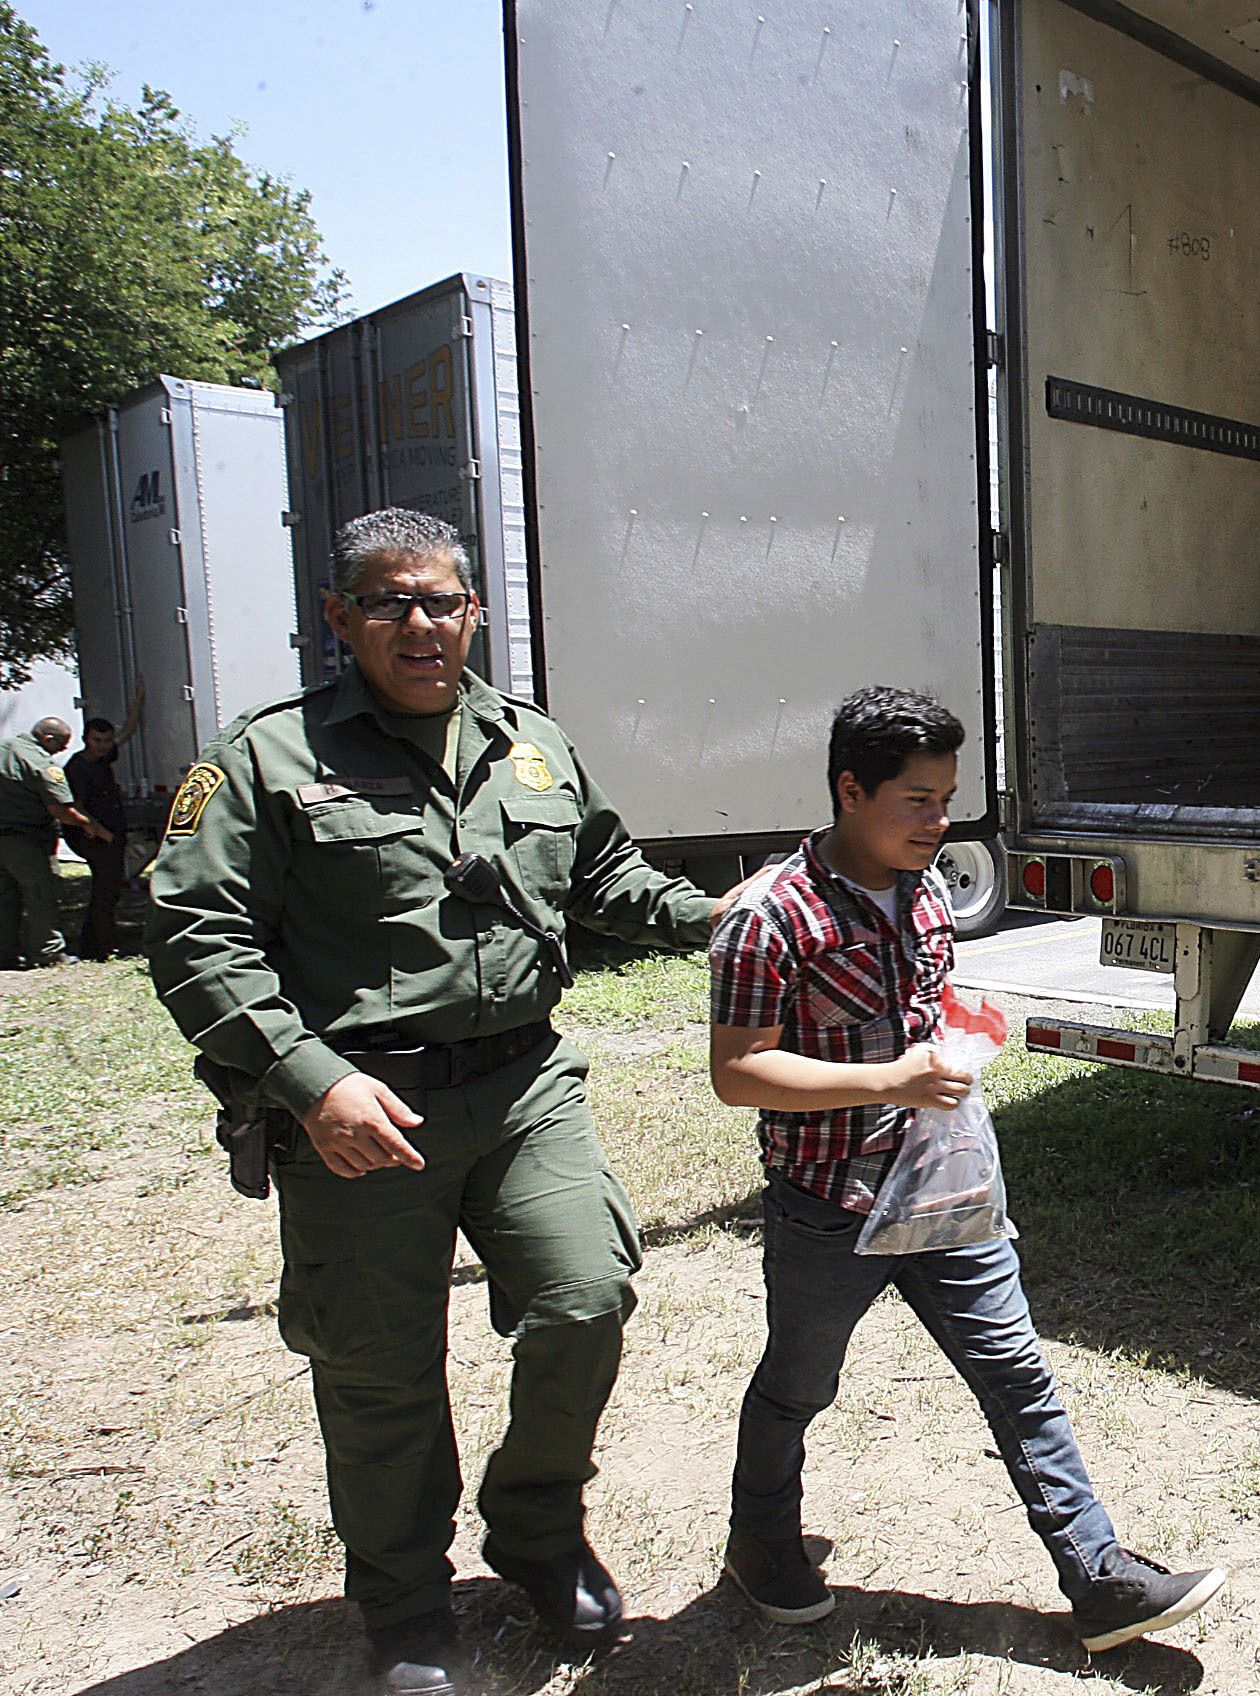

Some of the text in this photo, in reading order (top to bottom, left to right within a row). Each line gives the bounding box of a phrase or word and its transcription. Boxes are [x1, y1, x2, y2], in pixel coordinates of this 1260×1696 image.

[1120, 921, 1155, 931] FLORIDA
[1104, 932, 1169, 963] 067 4CL
